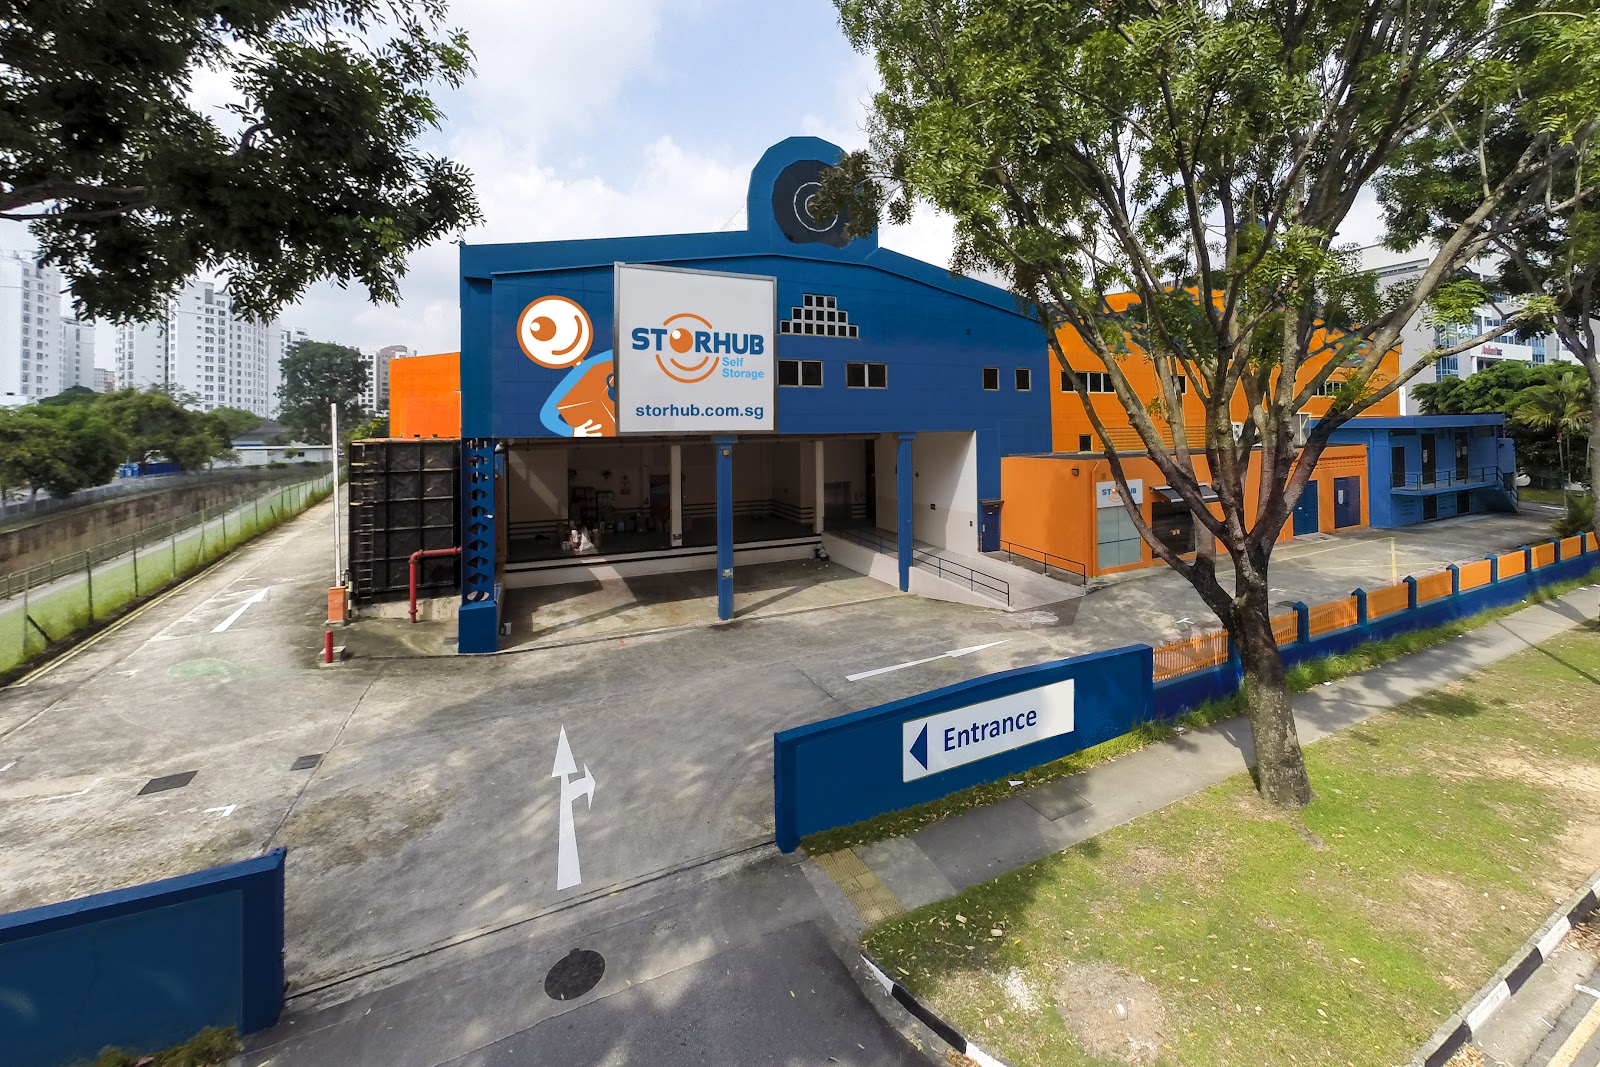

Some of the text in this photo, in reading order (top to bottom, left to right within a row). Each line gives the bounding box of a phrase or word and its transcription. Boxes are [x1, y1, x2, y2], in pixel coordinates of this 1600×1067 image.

[631, 327, 764, 355] STORHUB
[722, 356, 744, 367] Self
[722, 368, 764, 380] Storage
[635, 404, 764, 419] storhub.com.sg
[944, 709, 1037, 752] Entrance
